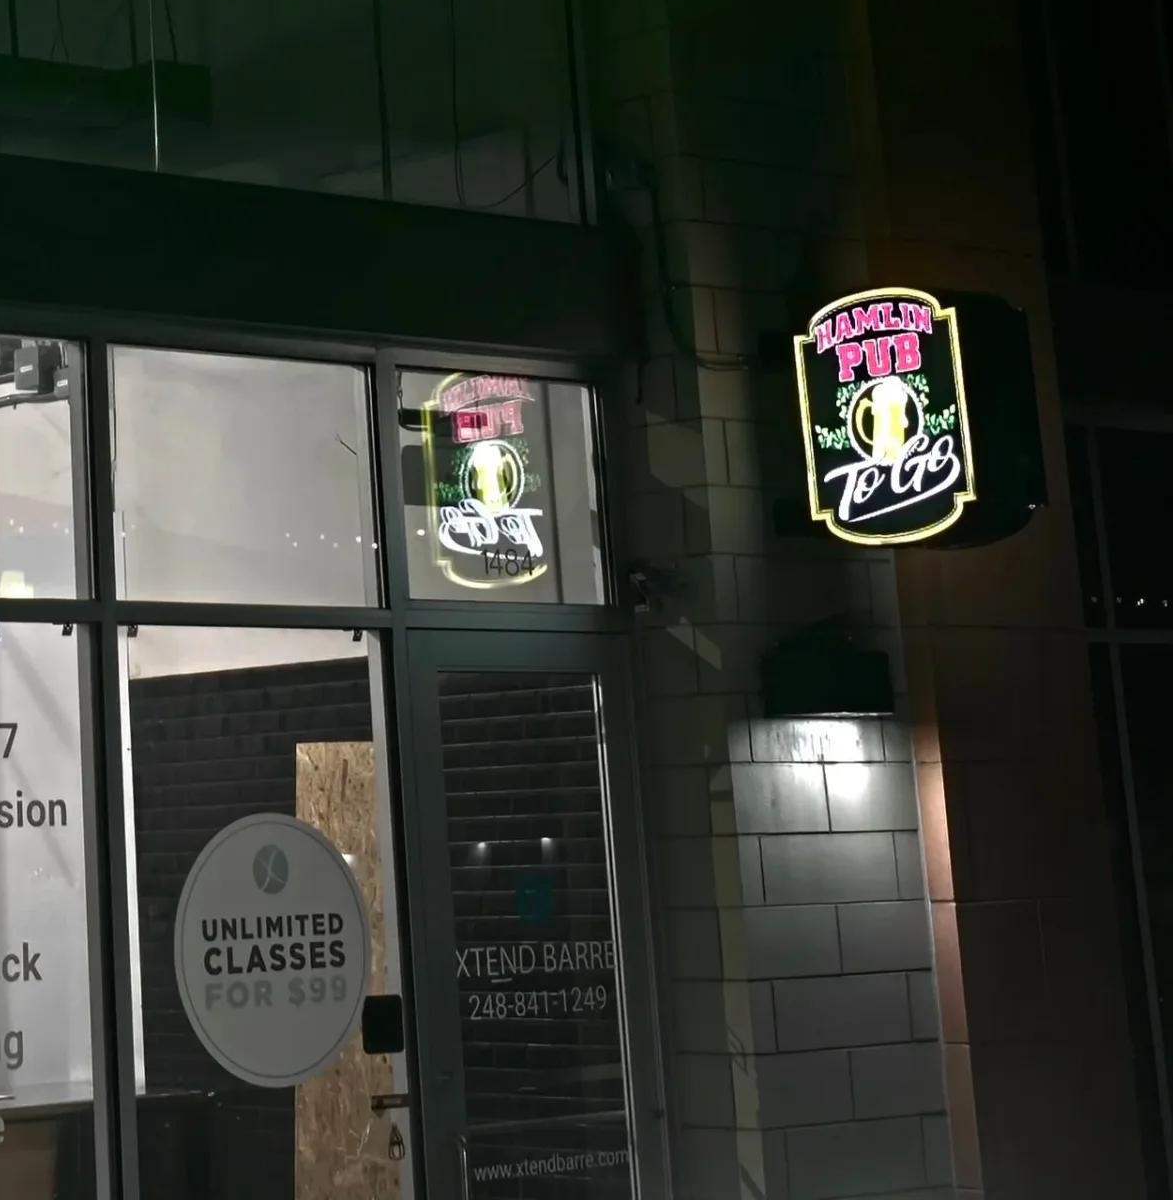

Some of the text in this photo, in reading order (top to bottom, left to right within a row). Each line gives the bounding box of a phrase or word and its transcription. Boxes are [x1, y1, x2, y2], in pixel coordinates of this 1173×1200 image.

[815, 302, 933, 353] HAMLIN
[835, 332, 922, 382] PUB
[824, 458, 885, 521] To
[481, 550, 535, 577] 1484
[201, 913, 343, 942] UNLIMITED
[203, 940, 346, 975] CLASSES
[455, 941, 615, 978] XTEND BARRE
[205, 975, 347, 1011] FOR $99
[468, 985, 607, 1020] 248-841-1249
[474, 1150, 628, 1182] www.xtendbarre.com
